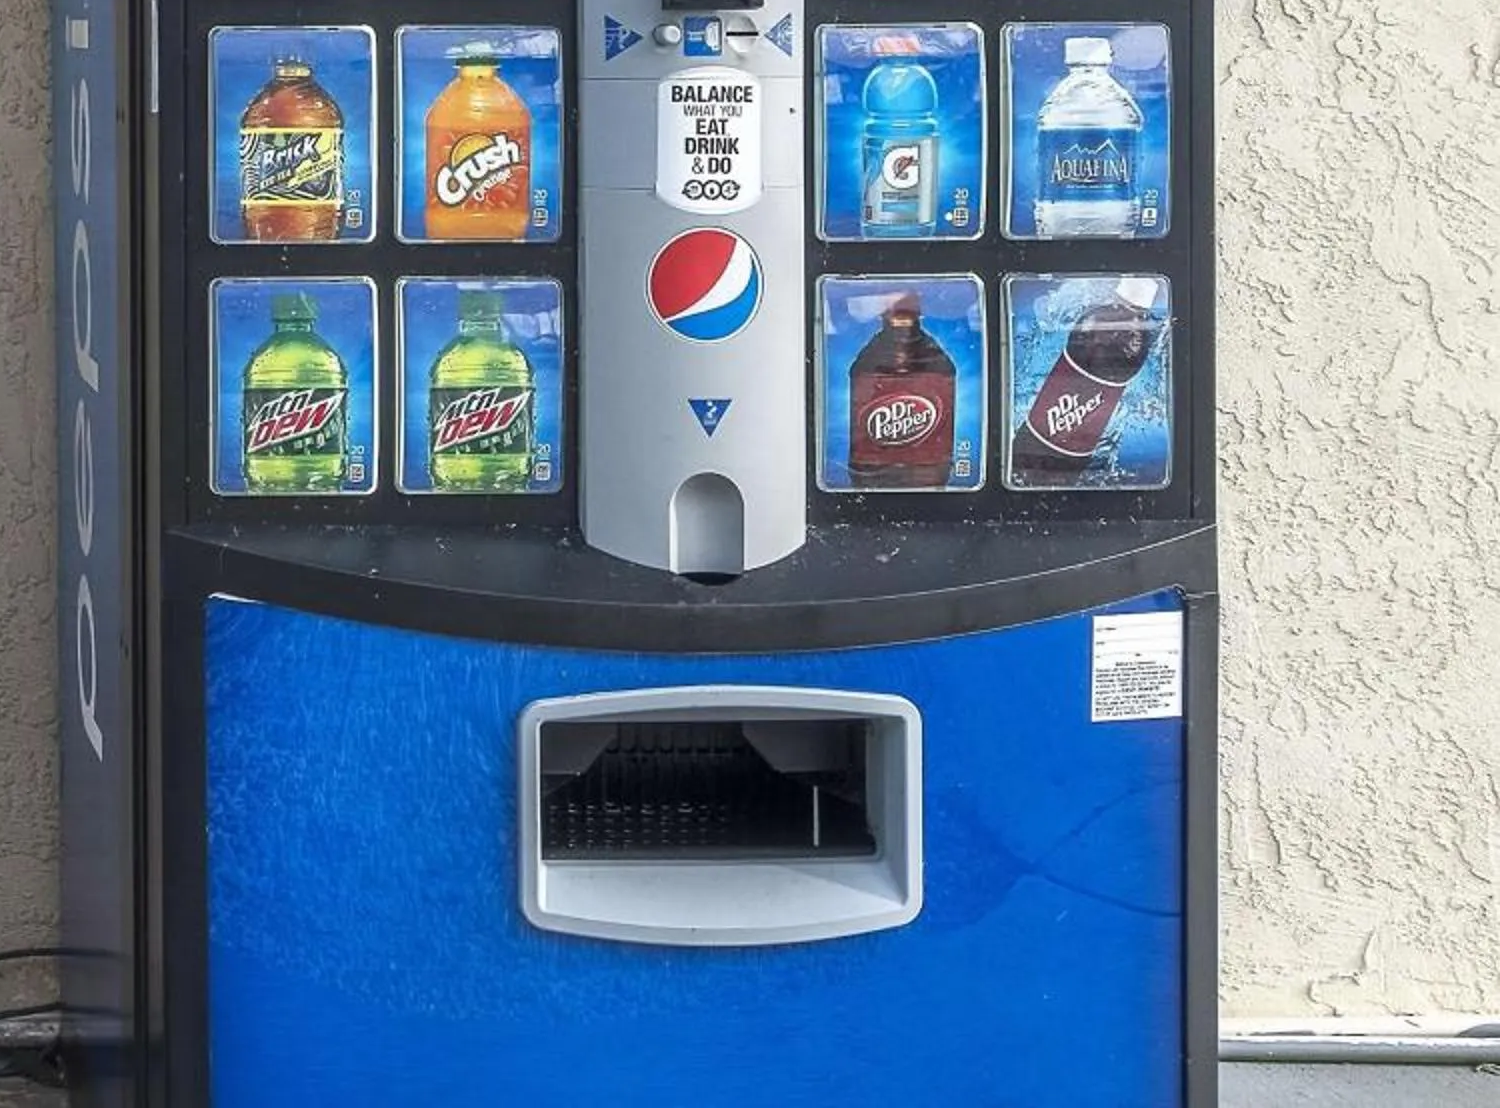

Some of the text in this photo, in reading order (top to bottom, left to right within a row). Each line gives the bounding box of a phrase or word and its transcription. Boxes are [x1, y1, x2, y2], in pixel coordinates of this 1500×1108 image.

[671, 85, 753, 103] BALANCE
[683, 105, 743, 117] WHAT YOU
[685, 137, 739, 154] DRINK
[436, 133, 520, 205] Crush
[691, 156, 731, 174] & DO
[1051, 153, 1129, 184] AQUAFINA
[64, 13, 104, 761] pepsi
[891, 401, 916, 422] Dr
[1047, 392, 1103, 437] Pepper
[1058, 393, 1080, 416] Dr
[873, 405, 931, 440] Pepper
